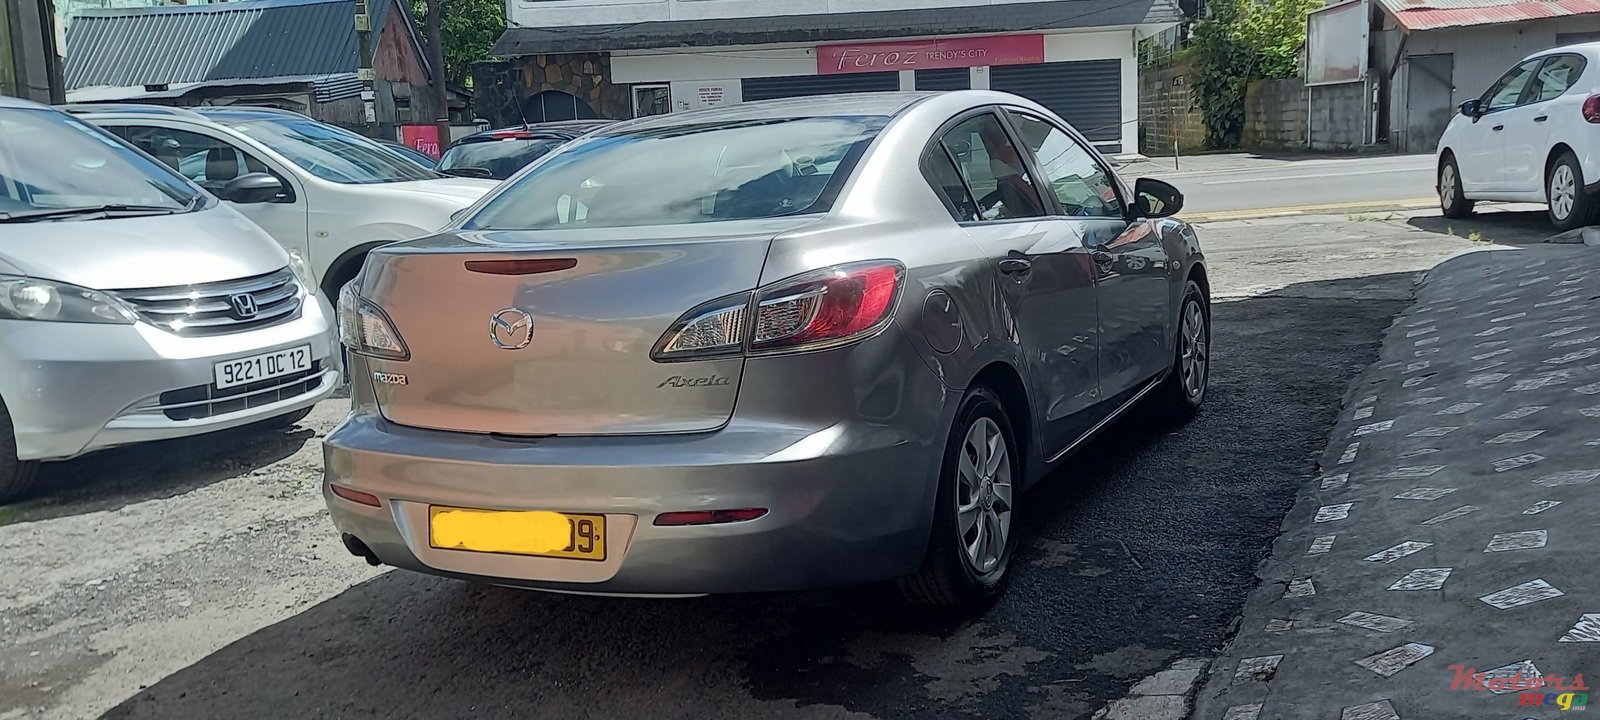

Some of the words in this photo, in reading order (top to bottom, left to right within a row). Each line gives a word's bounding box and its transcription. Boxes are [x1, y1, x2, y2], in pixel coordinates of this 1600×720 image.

[924, 49, 966, 61] TRENDY'S
[968, 48, 988, 59] CITY
[413, 137, 440, 157] Fero
[223, 358, 262, 384] 9221
[266, 354, 285, 375] DC
[289, 349, 305, 370] 12
[656, 374, 730, 389] Axela
